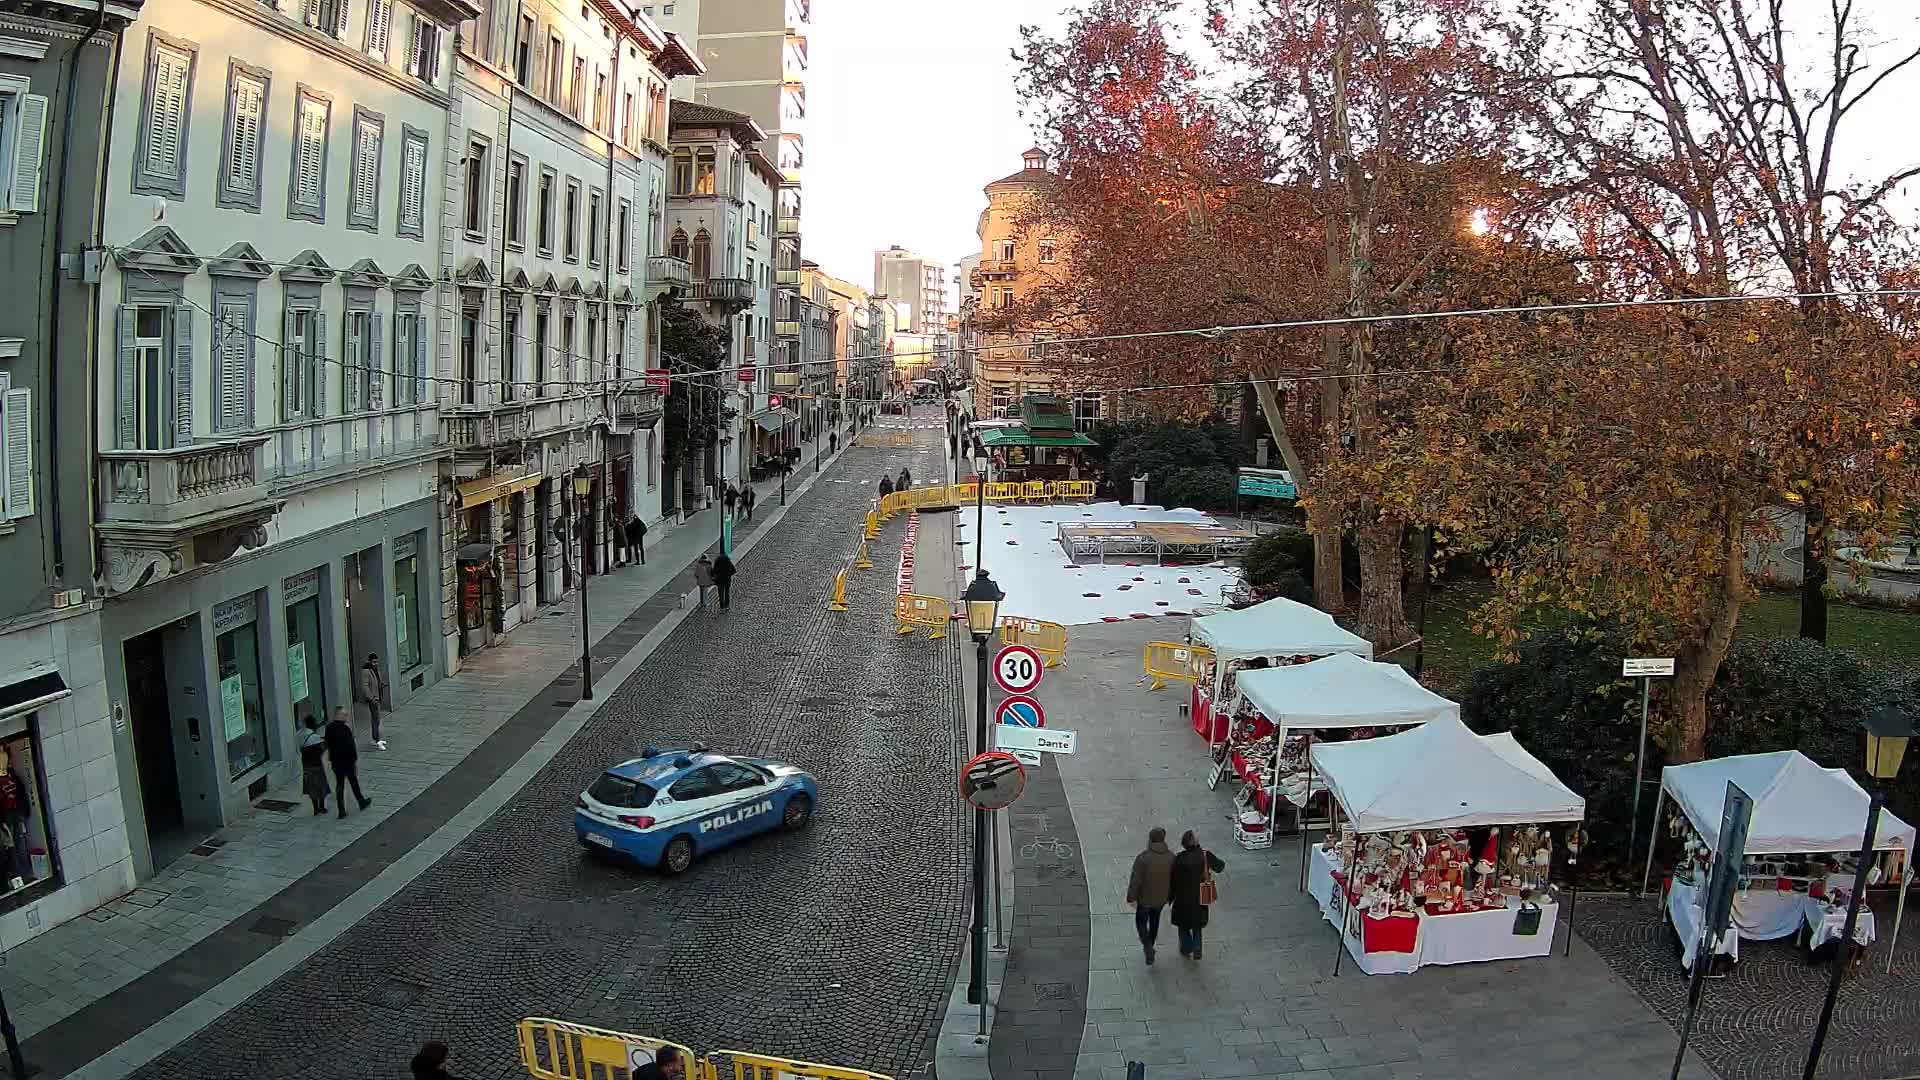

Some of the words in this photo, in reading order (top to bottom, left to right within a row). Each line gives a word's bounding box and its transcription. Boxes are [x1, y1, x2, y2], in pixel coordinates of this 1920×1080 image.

[1004, 658, 1033, 680] 30
[1038, 738, 1069, 749] Dante
[699, 799, 774, 833] POLIZIA
